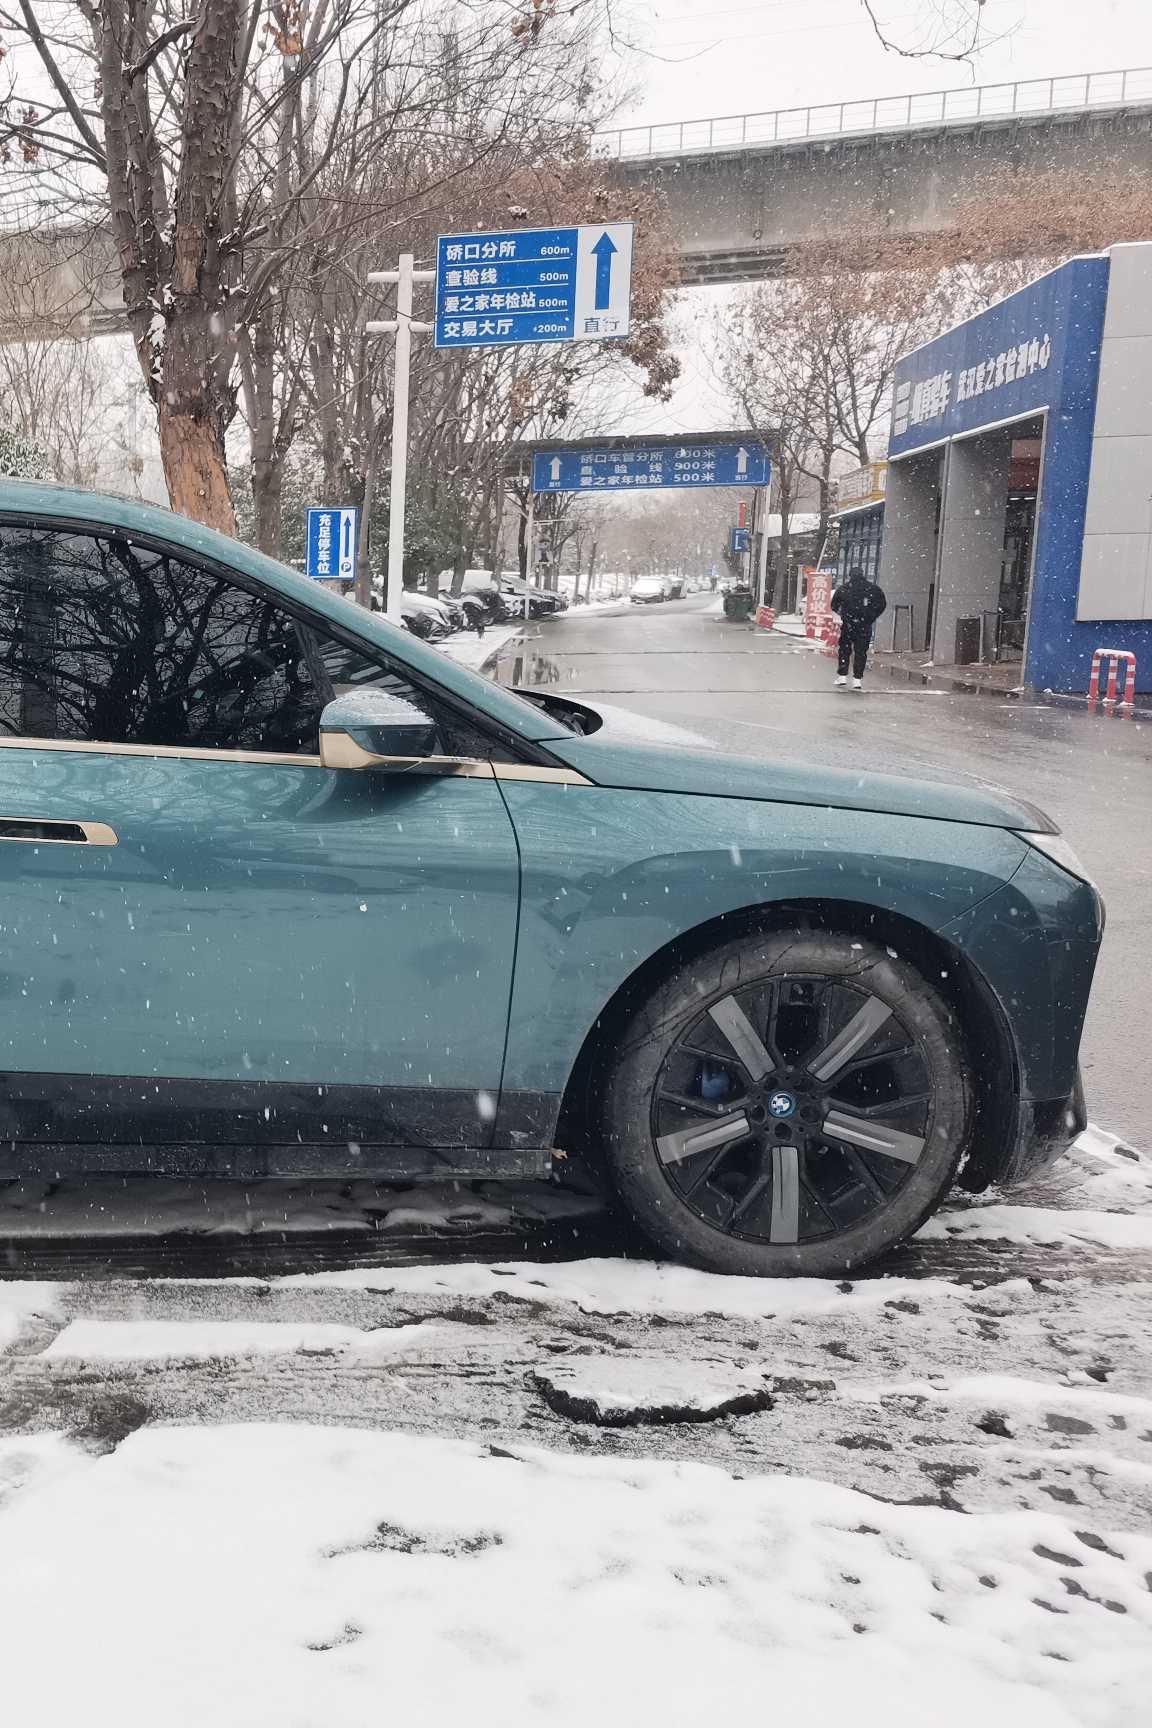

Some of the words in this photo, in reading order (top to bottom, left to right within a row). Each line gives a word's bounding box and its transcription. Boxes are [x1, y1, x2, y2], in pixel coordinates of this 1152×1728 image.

[446, 240, 516, 261] 硚口分所
[540, 245, 570, 255] 600m
[445, 268, 497, 286] 查验线
[539, 272, 569, 281] 500m
[444, 291, 536, 313] 爱之家年检站
[539, 298, 568, 307] 500m
[444, 318, 513, 338] 交易大厅
[538, 324, 567, 333] 200m
[583, 317, 620, 333] 直行
[673, 472, 715, 482] 500米
